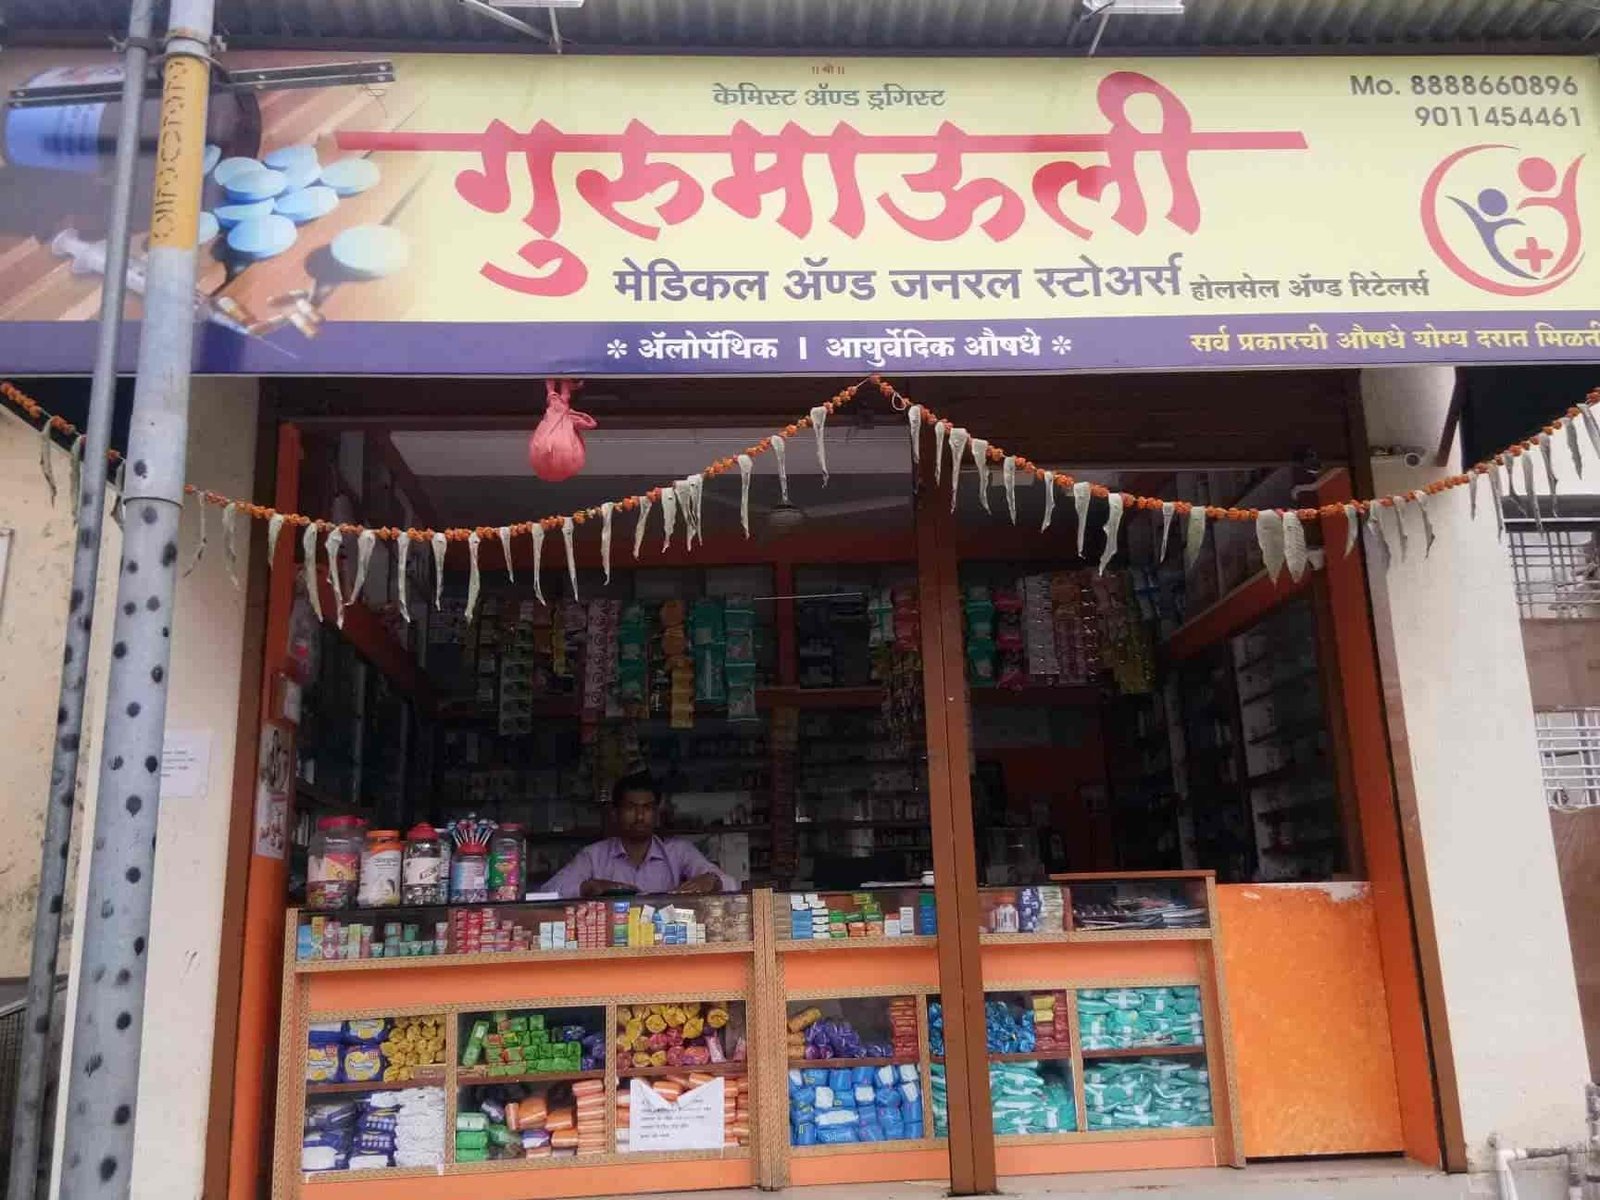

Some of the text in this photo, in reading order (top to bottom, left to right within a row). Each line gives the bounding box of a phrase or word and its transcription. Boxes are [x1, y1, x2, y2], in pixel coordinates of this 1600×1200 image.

[713, 82, 797, 106] केमिस्ट
[866, 83, 947, 111] ड्रगिस्ट
[1350, 74, 1579, 96] Mo. 8888660896
[1414, 105, 1582, 127] 9011454461
[612, 257, 769, 301] मेडिकल
[888, 268, 1023, 300] जनरल
[1033, 251, 1184, 299] स्टोअर्स
[1190, 272, 1280, 301] होलसेल
[1348, 269, 1430, 297] रिटेलर्स
[826, 328, 956, 367] आयुर्वेदिक
[963, 327, 1042, 357] औषधे
[1190, 325, 1231, 352] सर्व
[1237, 323, 1329, 351] प्रकारची
[1336, 323, 1407, 350] औषधे
[1411, 323, 1468, 348] योग्य
[1474, 329, 1529, 349] दरात
